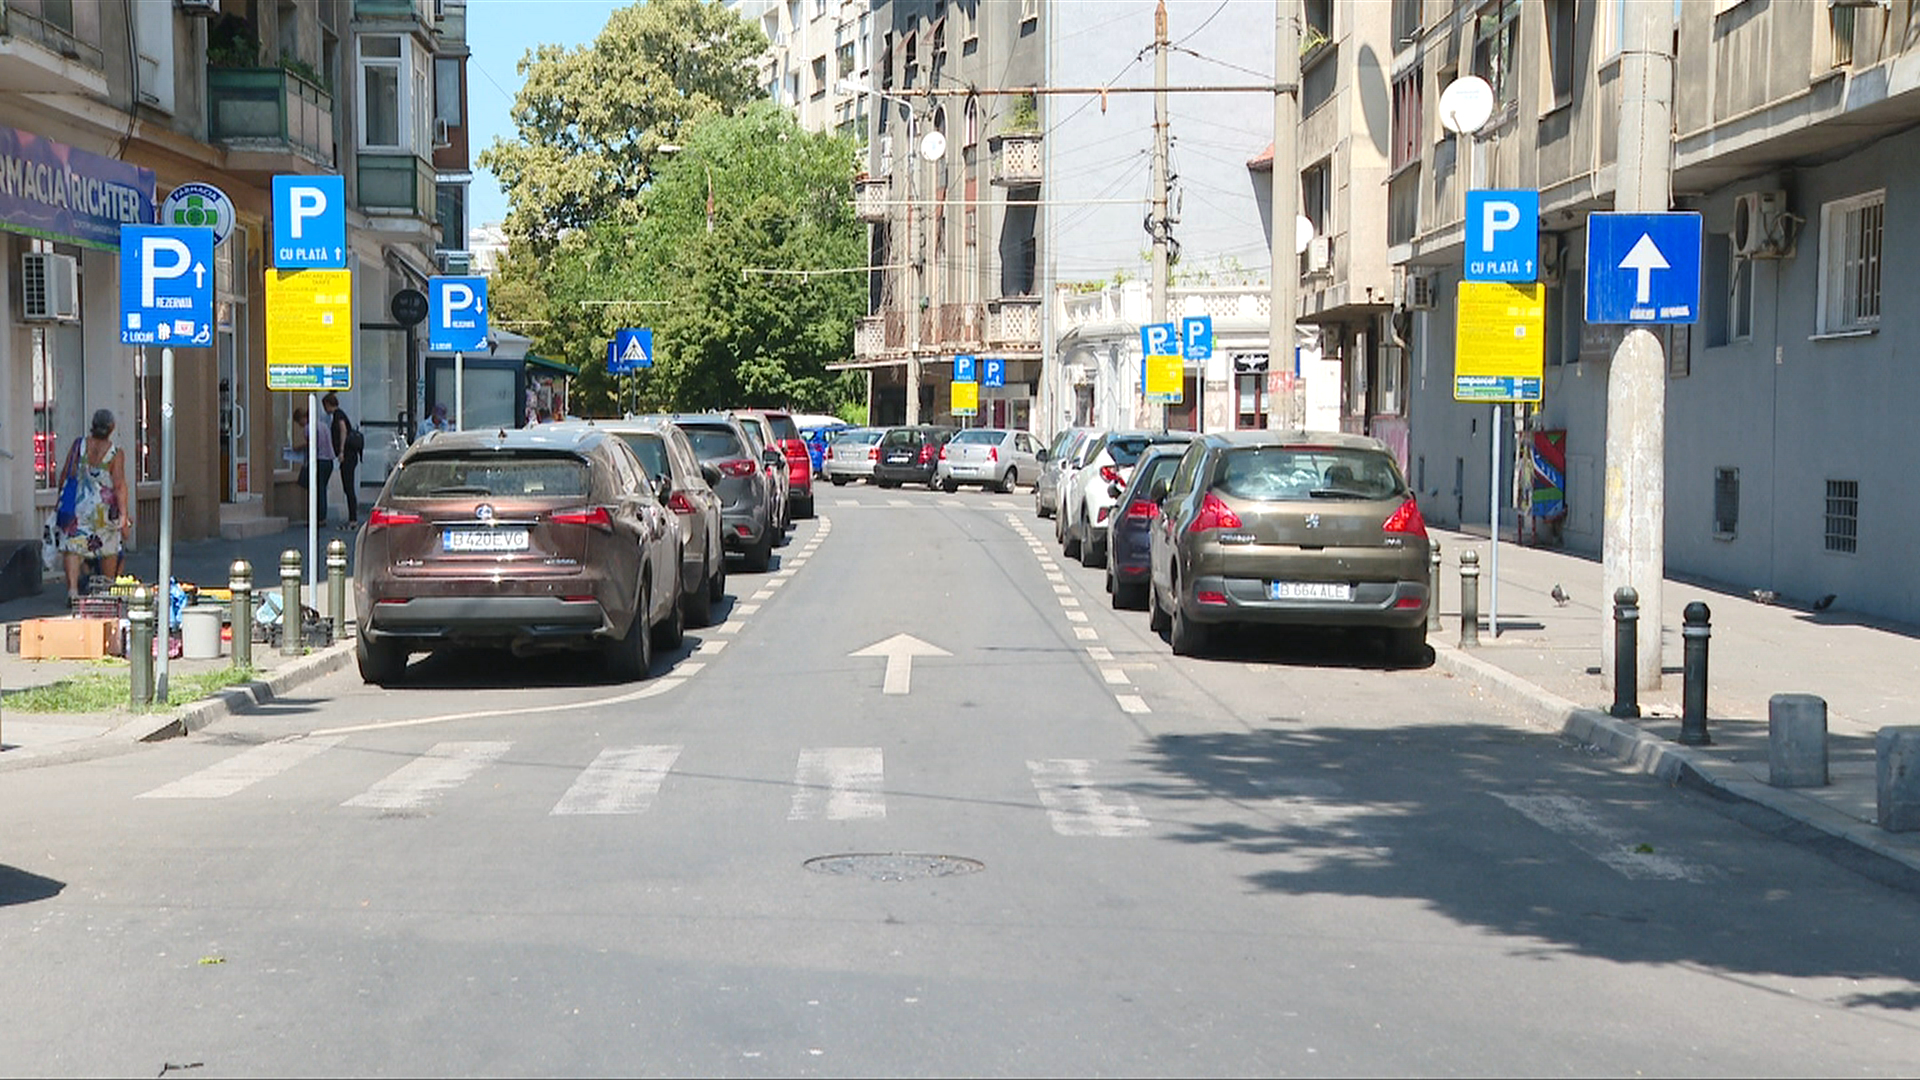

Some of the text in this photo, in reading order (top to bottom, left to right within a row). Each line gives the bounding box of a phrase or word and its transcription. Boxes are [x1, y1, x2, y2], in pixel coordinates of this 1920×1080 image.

[71, 172, 141, 224] RICHTER
[174, 185, 218, 201] FARMACIA
[290, 187, 327, 238] P
[1482, 201, 1520, 252] P
[280, 247, 294, 260] CU
[142, 237, 192, 308] P
[1471, 259, 1519, 274] CU PLATĂ
[442, 283, 474, 328] P
[122, 331, 129, 342] 2
[1189, 321, 1204, 347] P
[959, 358, 970, 374] P
[988, 362, 999, 378] P
[454, 532, 463, 546] B
[1281, 583, 1289, 596] B
